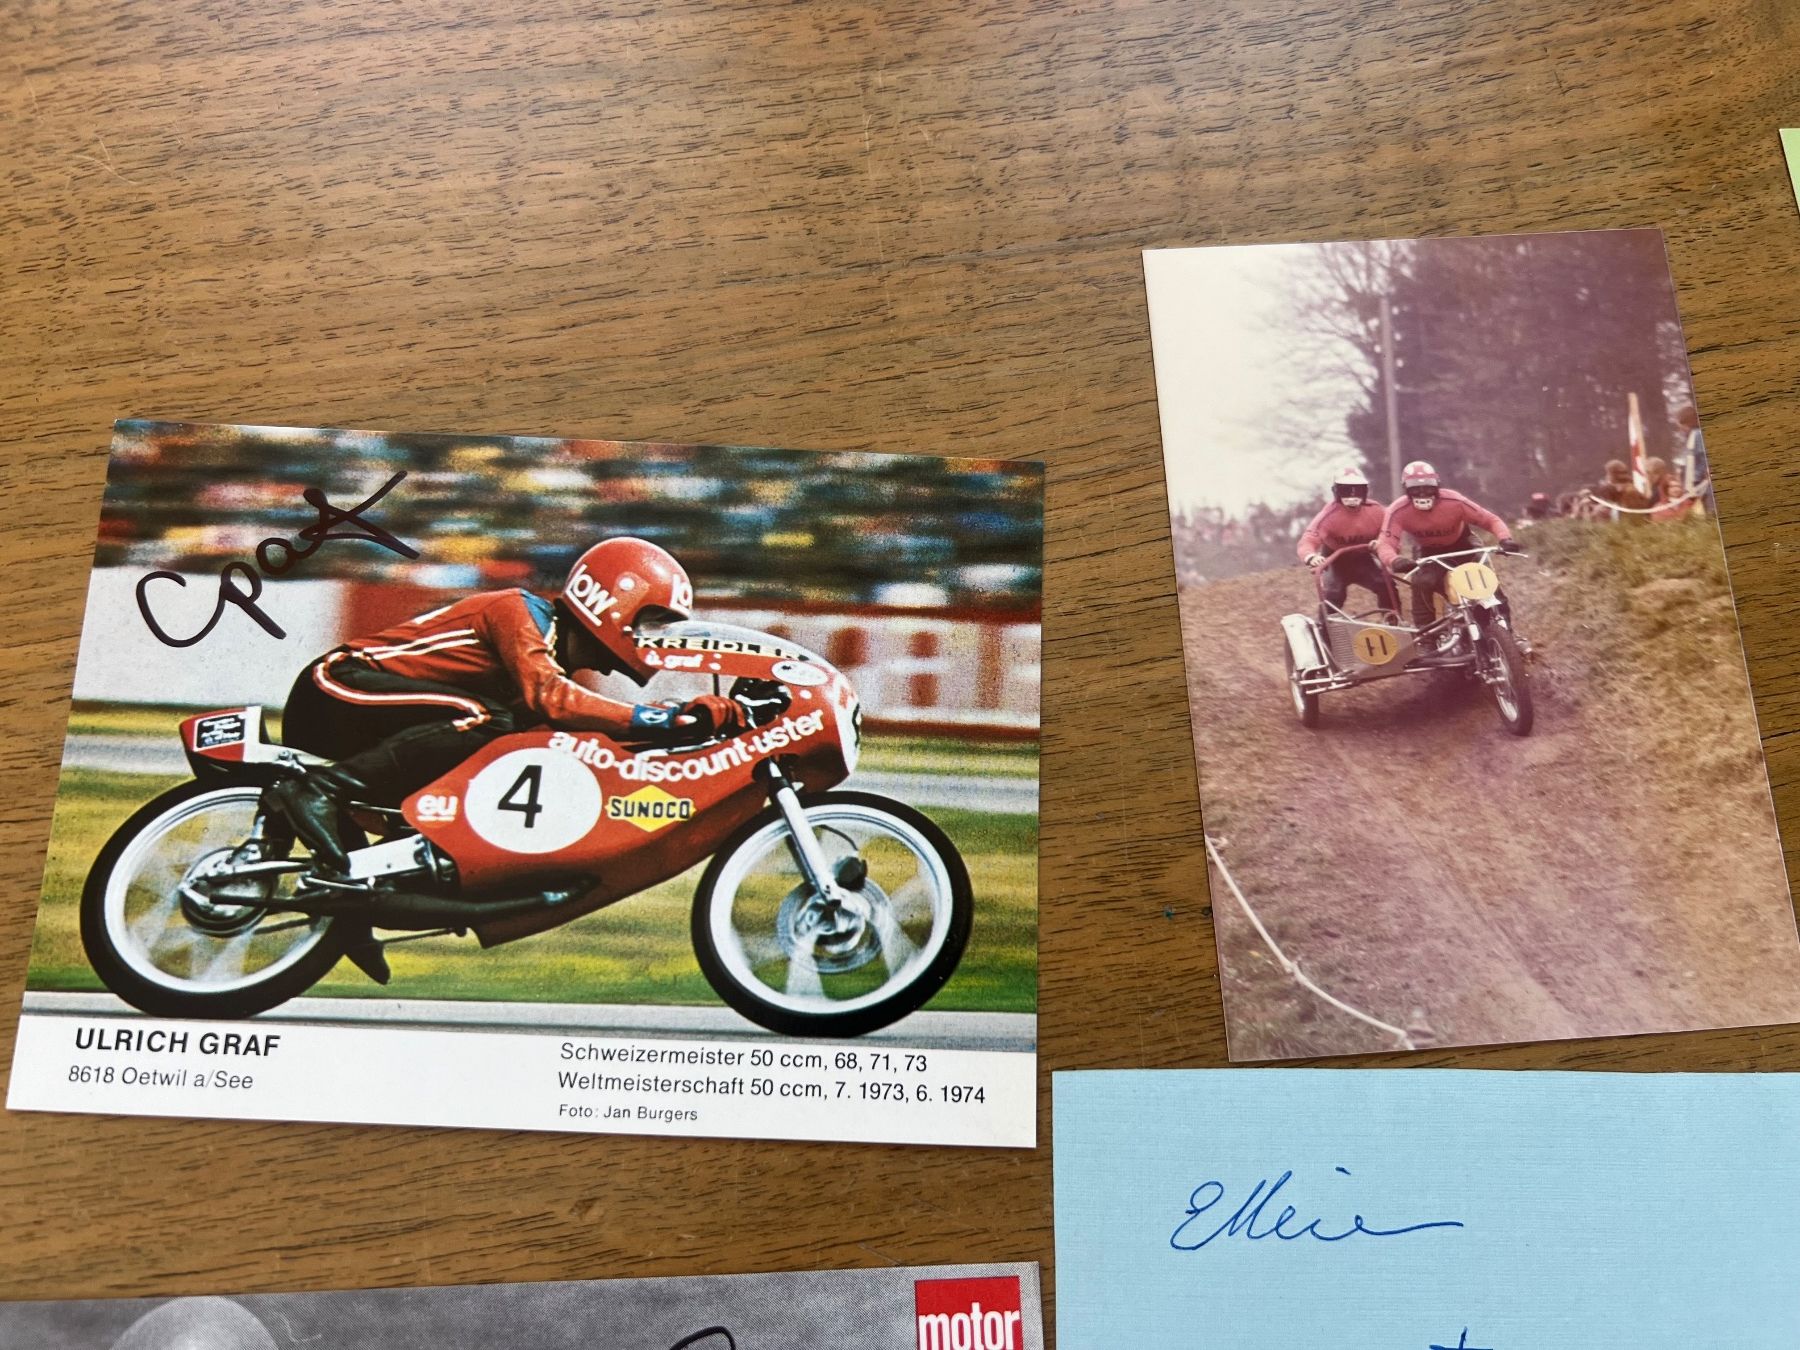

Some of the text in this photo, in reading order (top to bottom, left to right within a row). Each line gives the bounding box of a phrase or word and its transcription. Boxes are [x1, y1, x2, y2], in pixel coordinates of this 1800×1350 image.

[1464, 569, 1488, 591] 11
[496, 764, 543, 829] 4
[610, 798, 692, 820] SUNOCO
[75, 1027, 281, 1057] ULRICH GRAF
[560, 1042, 927, 1074] Schweizermeister 50 ccm, 68, 71, 73
[68, 1065, 253, 1089] 8618 Oetwil a/See
[558, 1071, 986, 1104] Weltmeisterschaft 50 ccm, 7. 1973, 6. 1974
[559, 1103, 698, 1123] Foto: Jan Burgers
[918, 1302, 1020, 1350] motor
